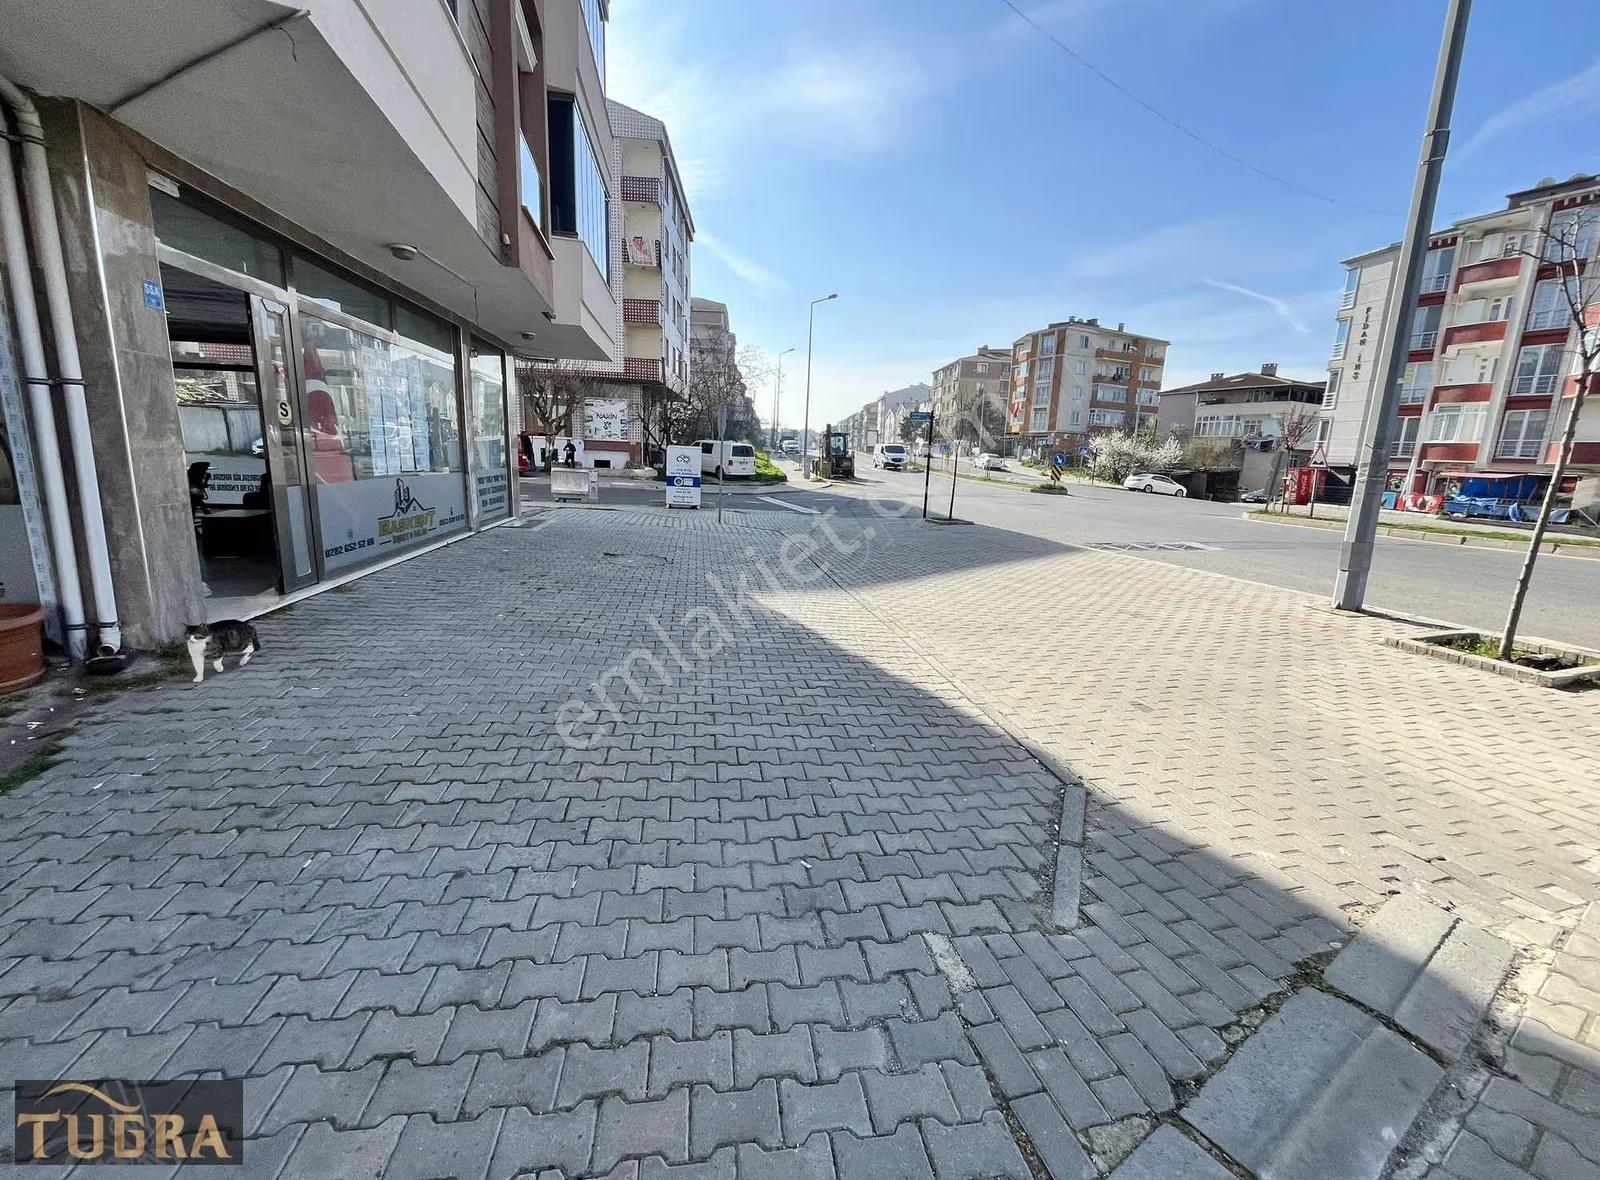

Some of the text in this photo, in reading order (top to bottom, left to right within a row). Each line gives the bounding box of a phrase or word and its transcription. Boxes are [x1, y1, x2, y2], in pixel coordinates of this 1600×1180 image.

[280, 402, 289, 417] S
[325, 546, 344, 558] 0282
[344, 542, 357, 552] 652
